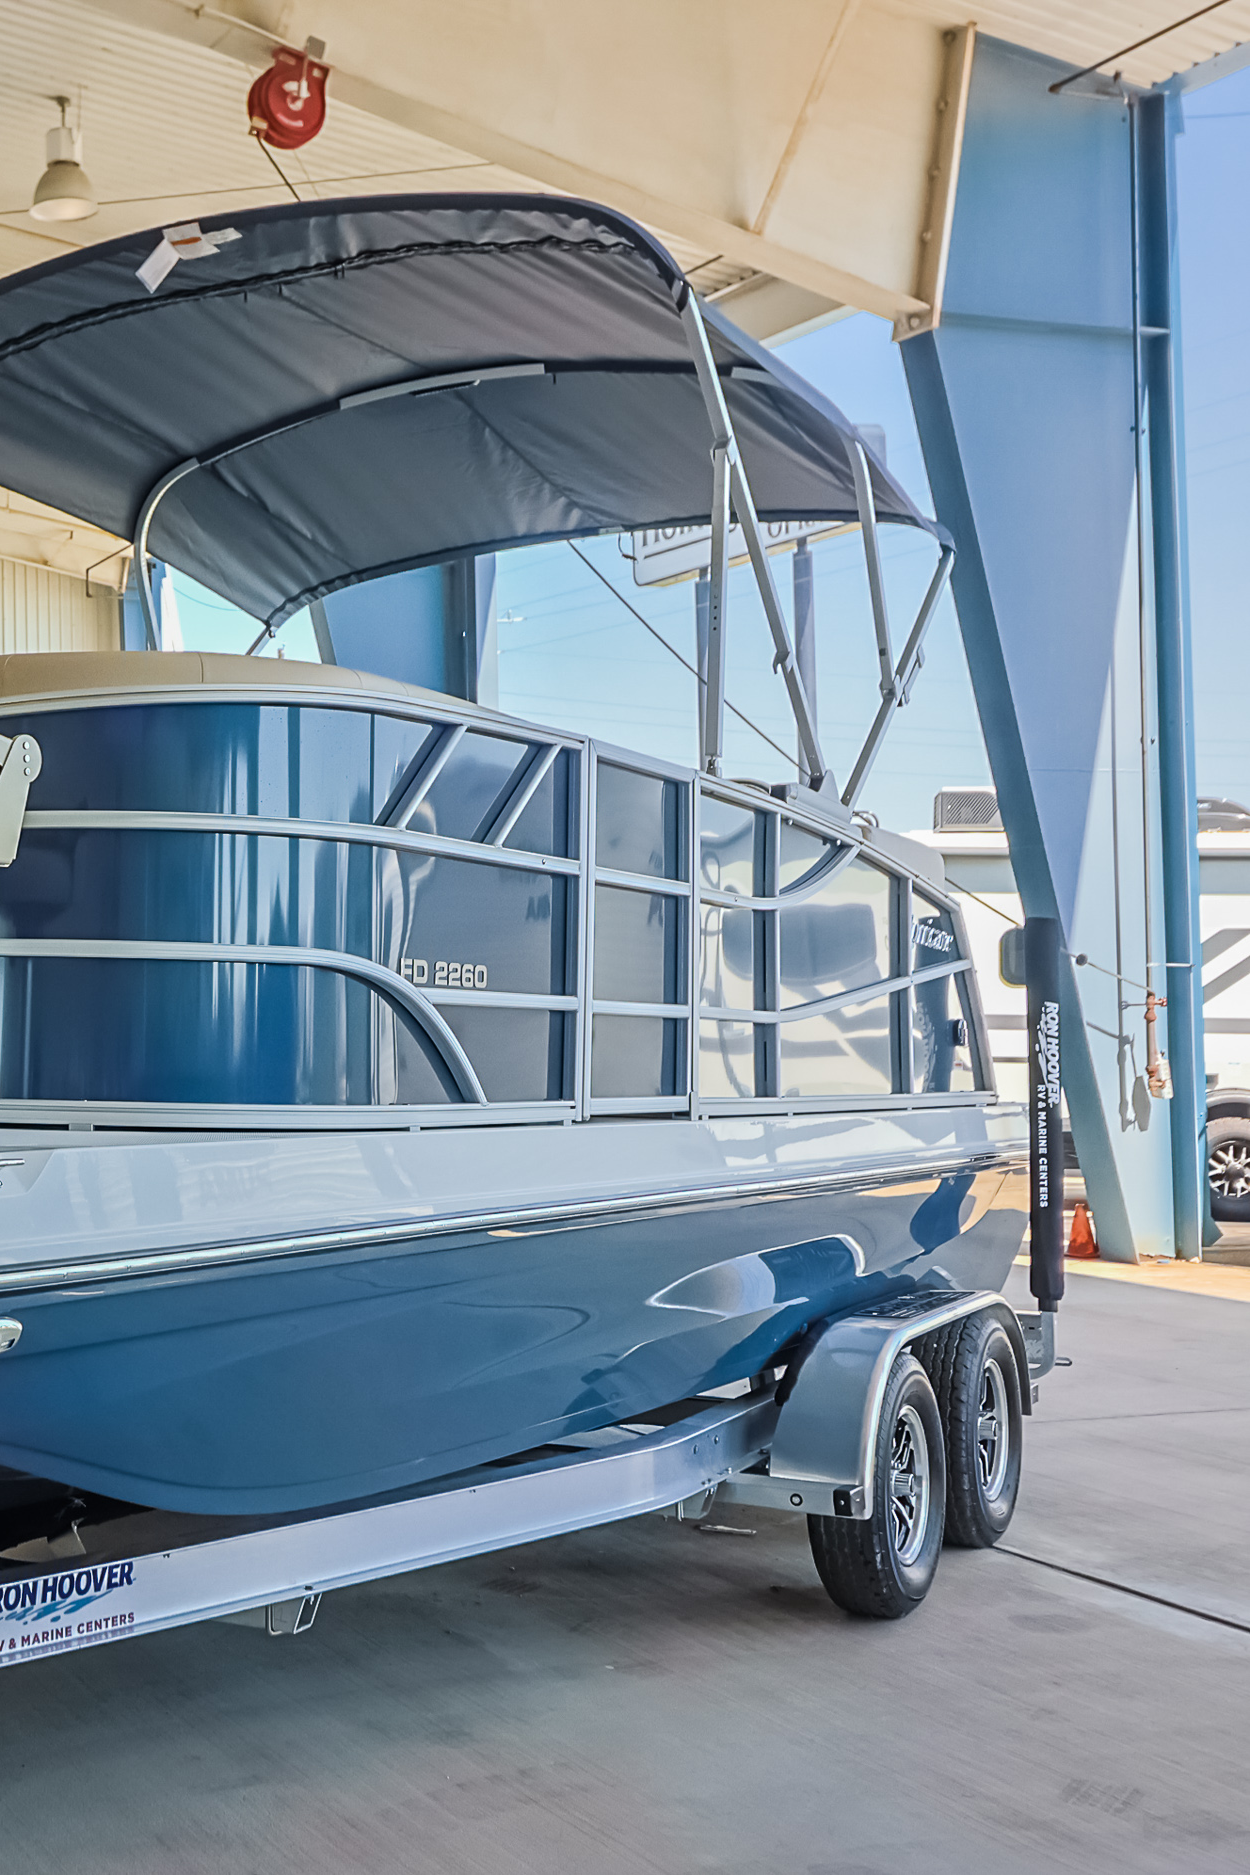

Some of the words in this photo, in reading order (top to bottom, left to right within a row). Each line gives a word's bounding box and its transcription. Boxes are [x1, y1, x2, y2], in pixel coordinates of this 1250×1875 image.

[400, 958, 428, 984] FD
[434, 961, 488, 988] 2260
[1044, 1001, 1059, 1037] RON
[1047, 1037, 1060, 1106] HOOVER
[1037, 1085, 1046, 1099] RV
[1038, 1112, 1048, 1155] MARINE
[1039, 1158, 1049, 1208] CENTERS
[41, 1561, 134, 1603] HOOVER
[8, 1638, 16, 1650] &
[21, 1625, 72, 1647] MARINE
[77, 1612, 135, 1634] CENTERS
